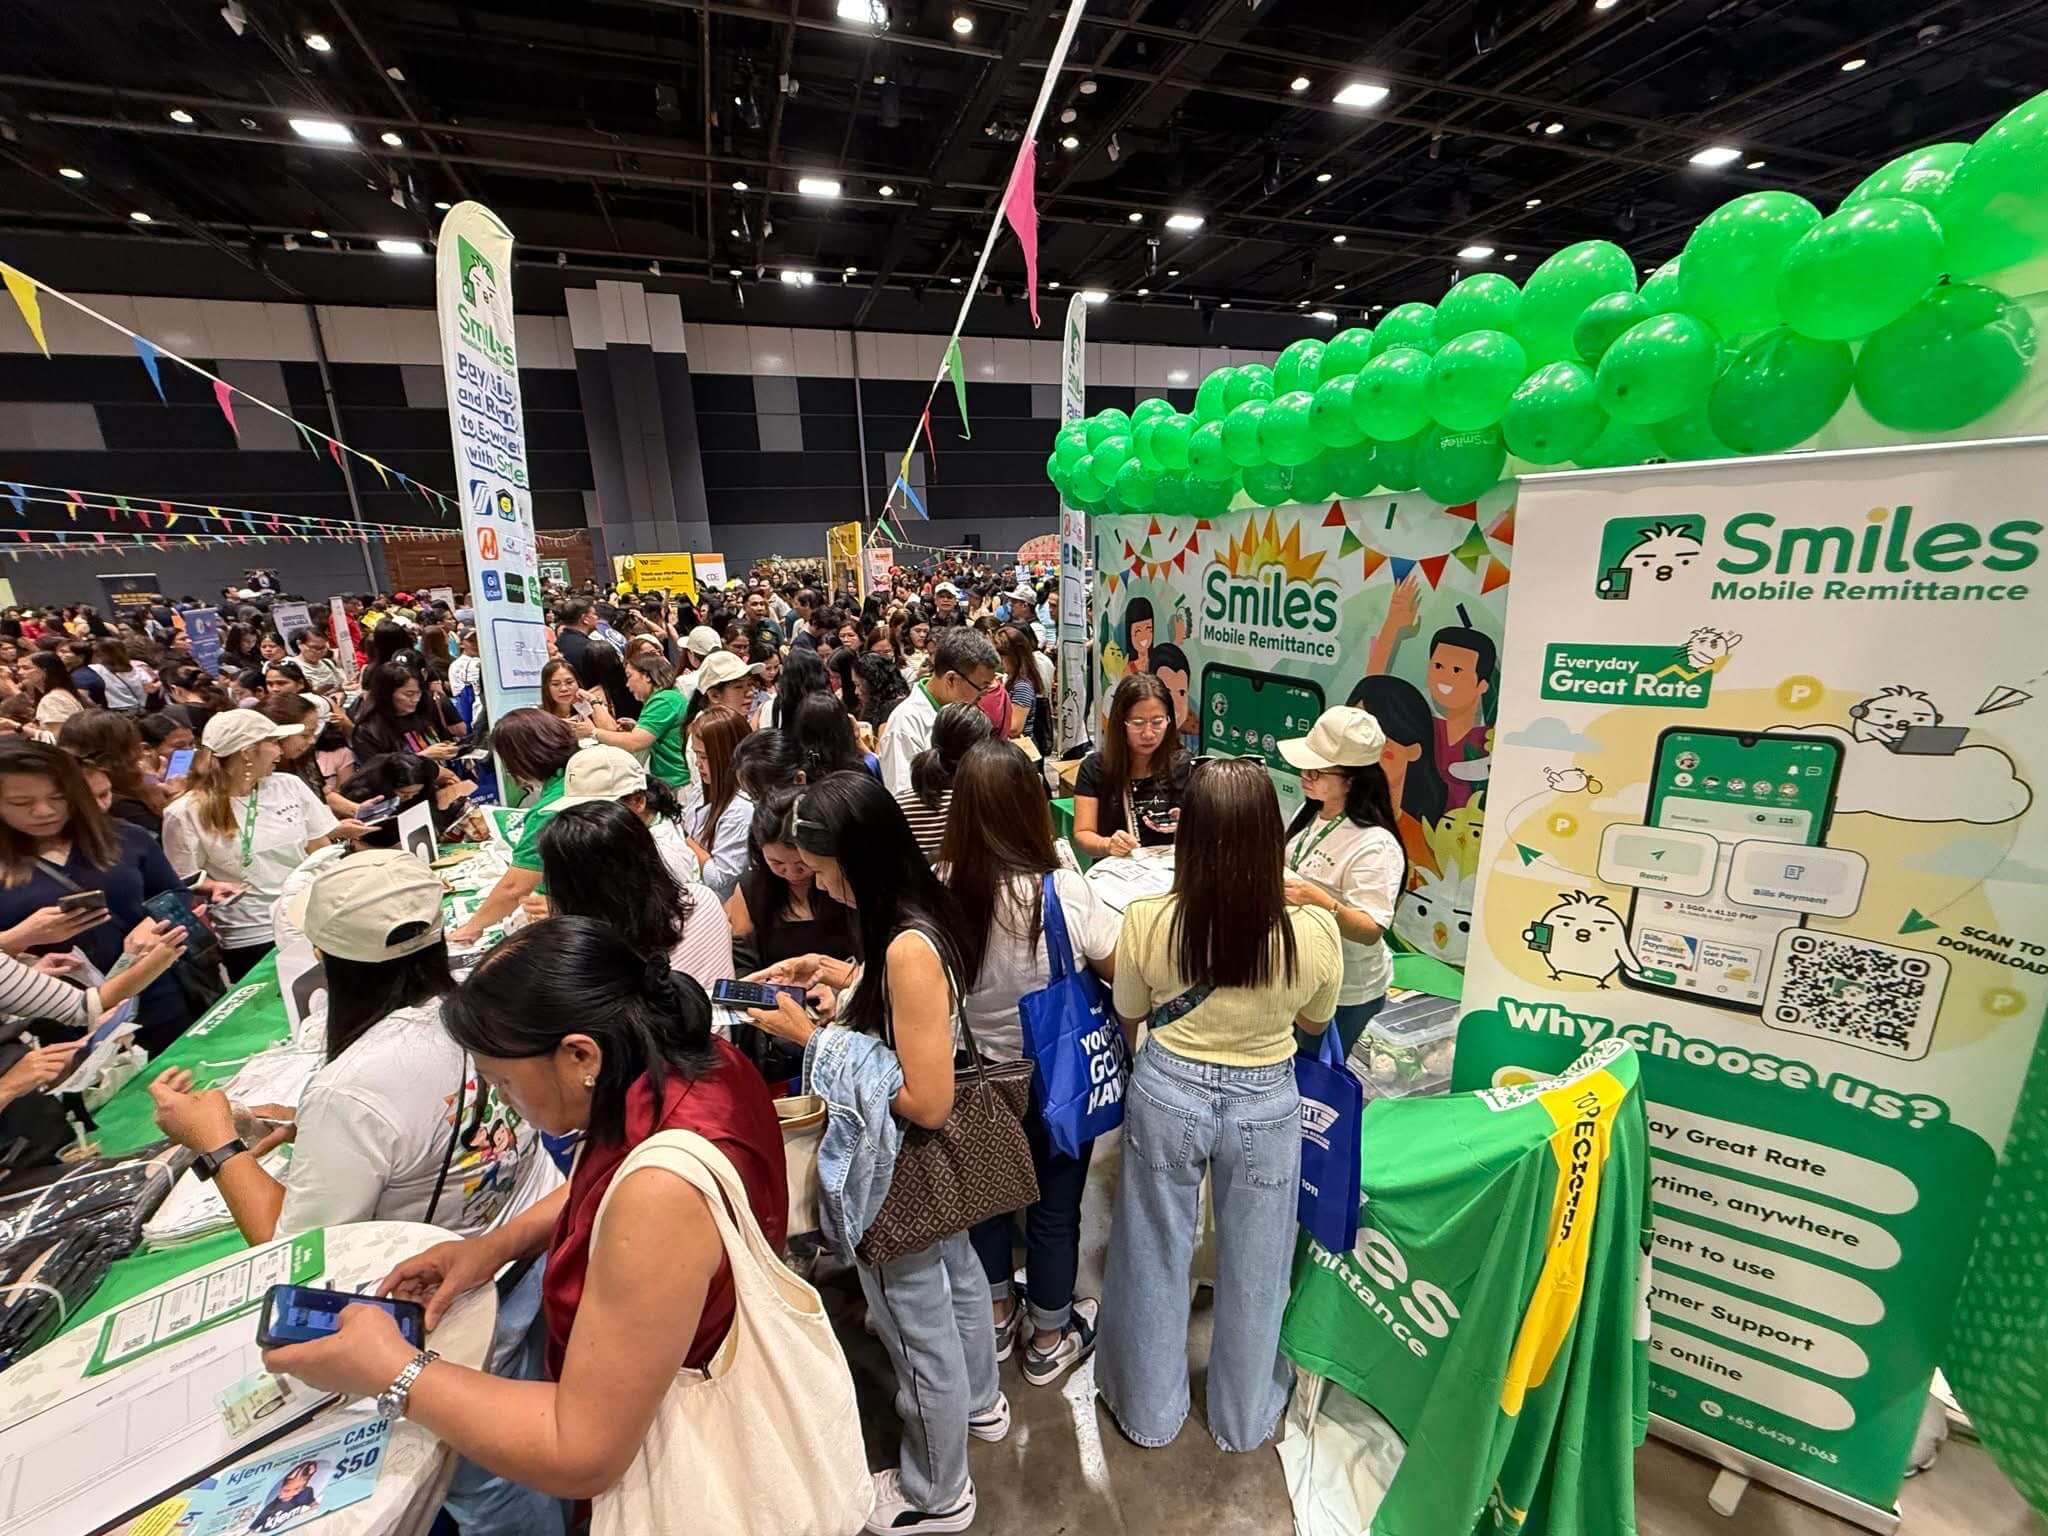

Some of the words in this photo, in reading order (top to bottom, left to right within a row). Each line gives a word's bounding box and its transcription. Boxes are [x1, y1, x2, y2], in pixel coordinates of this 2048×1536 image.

[458, 387, 481, 407] and
[461, 414, 474, 431] to
[468, 446, 494, 469] with
[1440, 434, 1482, 449] Smiles
[1717, 505, 2045, 575] Smiles
[1205, 569, 1339, 633] Smiles
[1711, 580, 1814, 601] Mobile
[1823, 579, 2030, 601] Remittance
[1203, 625, 1245, 646] Mobile
[1248, 631, 1336, 658] Remittance
[1553, 653, 1640, 674] Everyday
[1549, 669, 1628, 697] Great
[1634, 673, 1703, 699] Rate
[1752, 888, 1776, 899] Bills
[1777, 890, 1828, 905] Payment
[1937, 935, 2048, 975] DOWNLOAD
[1960, 926, 2015, 948] SCAN
[2019, 941, 2046, 956] TO
[1504, 1000, 1608, 1048] Why
[1624, 1026, 1820, 1091] choose
[1830, 1077, 1943, 1127] us?
[1648, 1116, 1680, 1140] ay
[1686, 1128, 1757, 1158] Great
[1765, 1148, 1827, 1177] Rate
[1727, 1196, 1860, 1248] anywhere
[1700, 1244, 1725, 1264] to
[1732, 1257, 1776, 1280] use
[1711, 1304, 1815, 1352] Support
[1670, 1344, 1743, 1382] online
[343, 1418, 389, 1446] CASH
[1726, 1413, 1754, 1430] +65
[1757, 1425, 1796, 1447] 6429
[1799, 1441, 1839, 1465] 1063
[333, 1445, 380, 1480] $50
